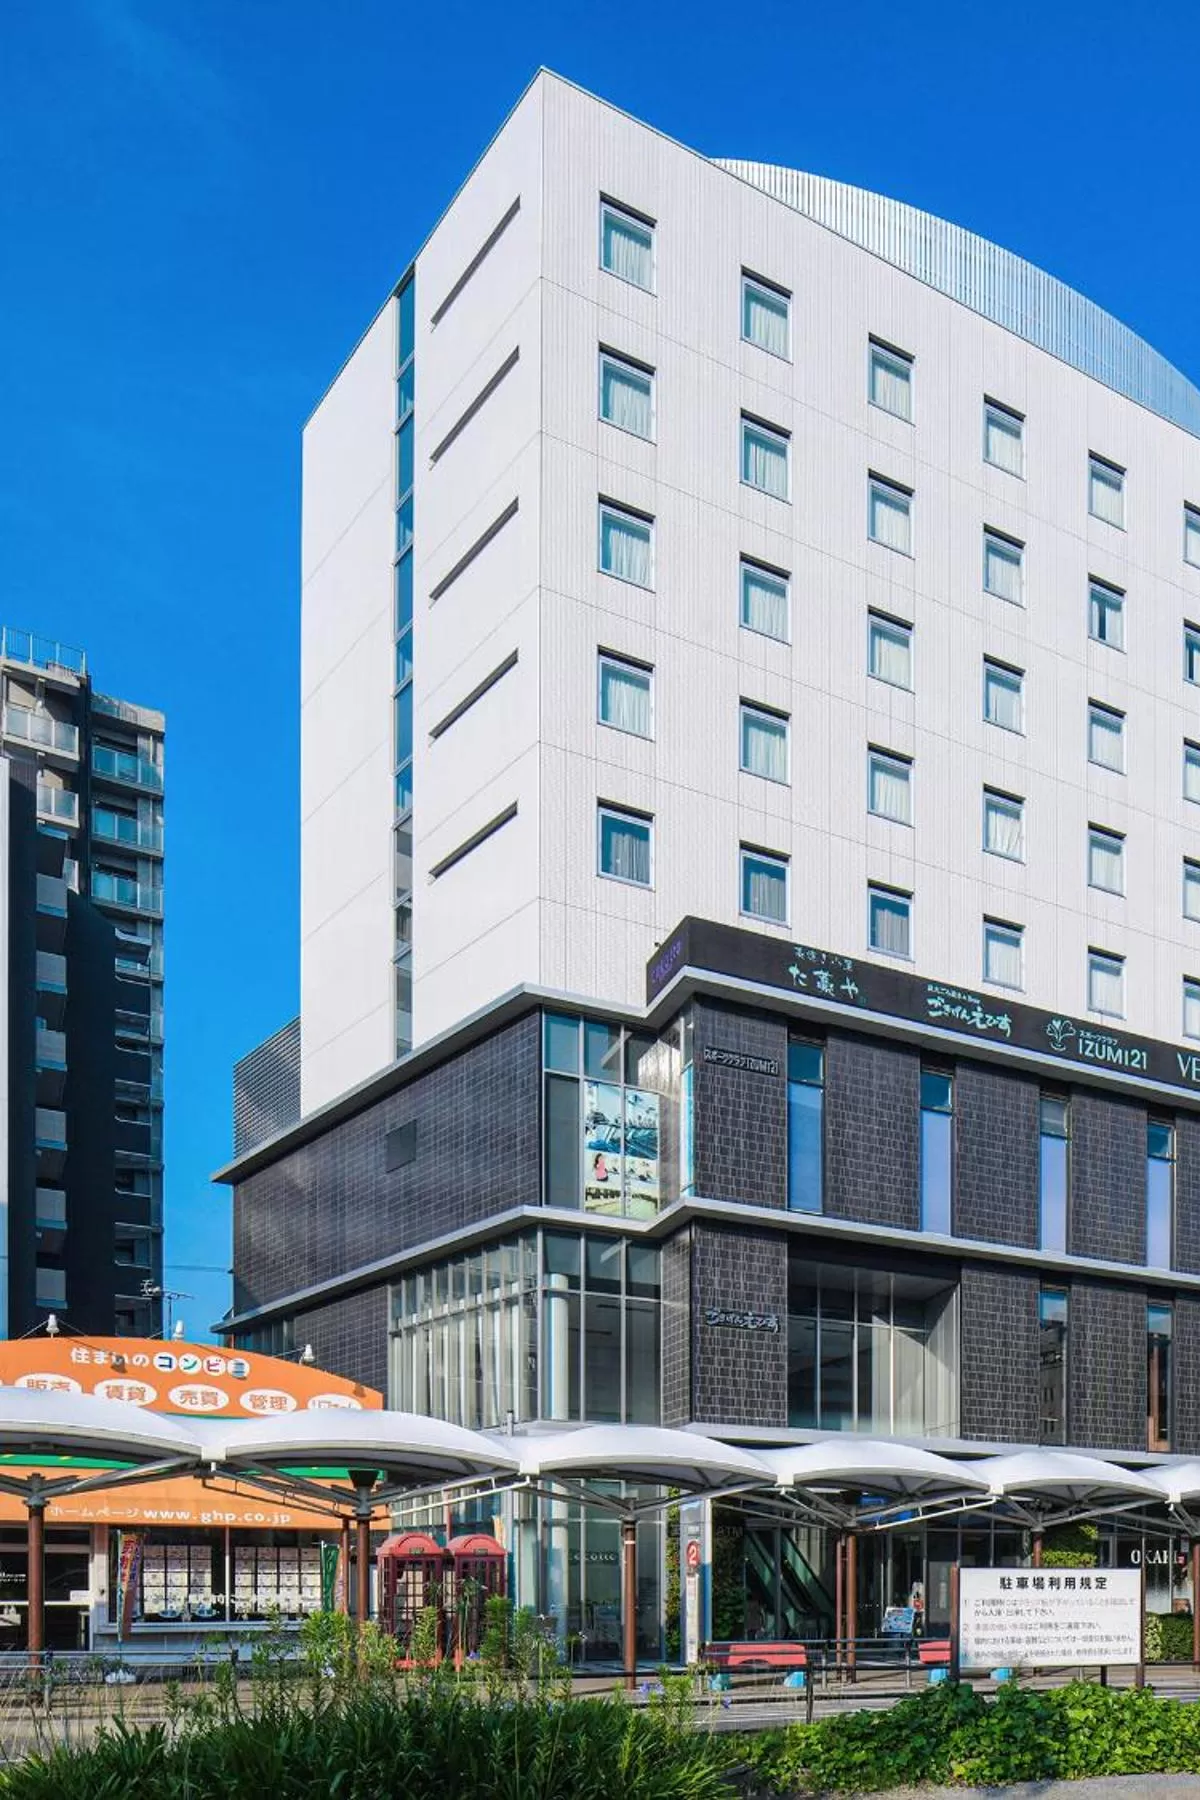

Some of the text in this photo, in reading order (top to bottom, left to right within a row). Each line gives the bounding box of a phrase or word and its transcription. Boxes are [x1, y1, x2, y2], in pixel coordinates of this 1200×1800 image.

[1078, 1038, 1147, 1071] IZUMI21
[179, 1388, 219, 1406] 売買
[248, 1394, 288, 1410] 管理
[50, 1505, 291, 1524] ホームページ www.ghp.co.jp
[999, 1576, 1108, 1590] 駐車場利用規定
